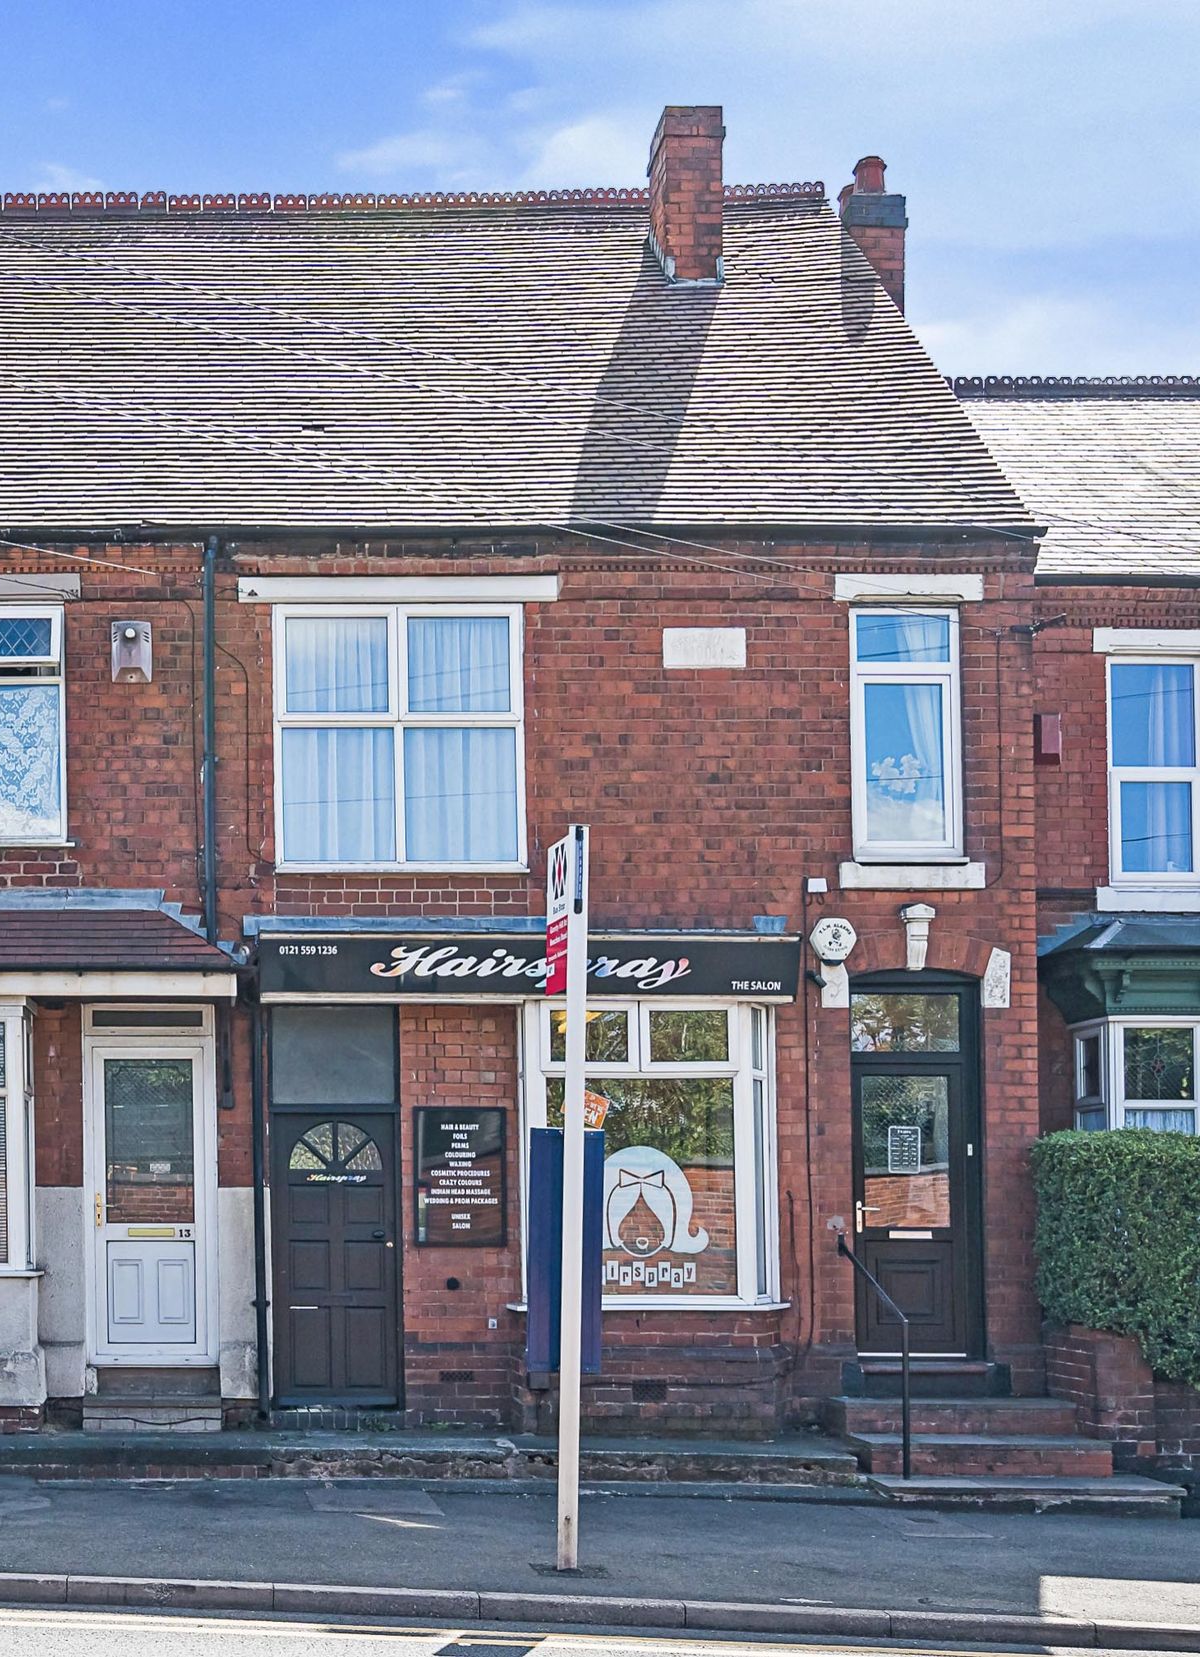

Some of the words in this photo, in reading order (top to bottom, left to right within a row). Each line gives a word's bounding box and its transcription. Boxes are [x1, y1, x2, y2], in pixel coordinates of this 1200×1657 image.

[279, 945, 299, 955] 0121
[300, 945, 316, 955] 559
[317, 945, 338, 955] 1236
[370, 946, 692, 989] Hairsray
[731, 980, 749, 991] THE
[750, 980, 781, 991] SALON
[440, 1123, 454, 1131] HAIR
[454, 1123, 459, 1131] &
[459, 1123, 480, 1131] BEAUTY
[452, 1132, 468, 1140] FOILS
[430, 1169, 457, 1177] COSMETIC
[457, 1169, 491, 1177] PROCEDURES
[306, 1173, 367, 1183] Hairspray
[452, 1222, 471, 1230] SALON
[179, 1229, 191, 1238] 13
[611, 1265, 693, 1284] irspray
